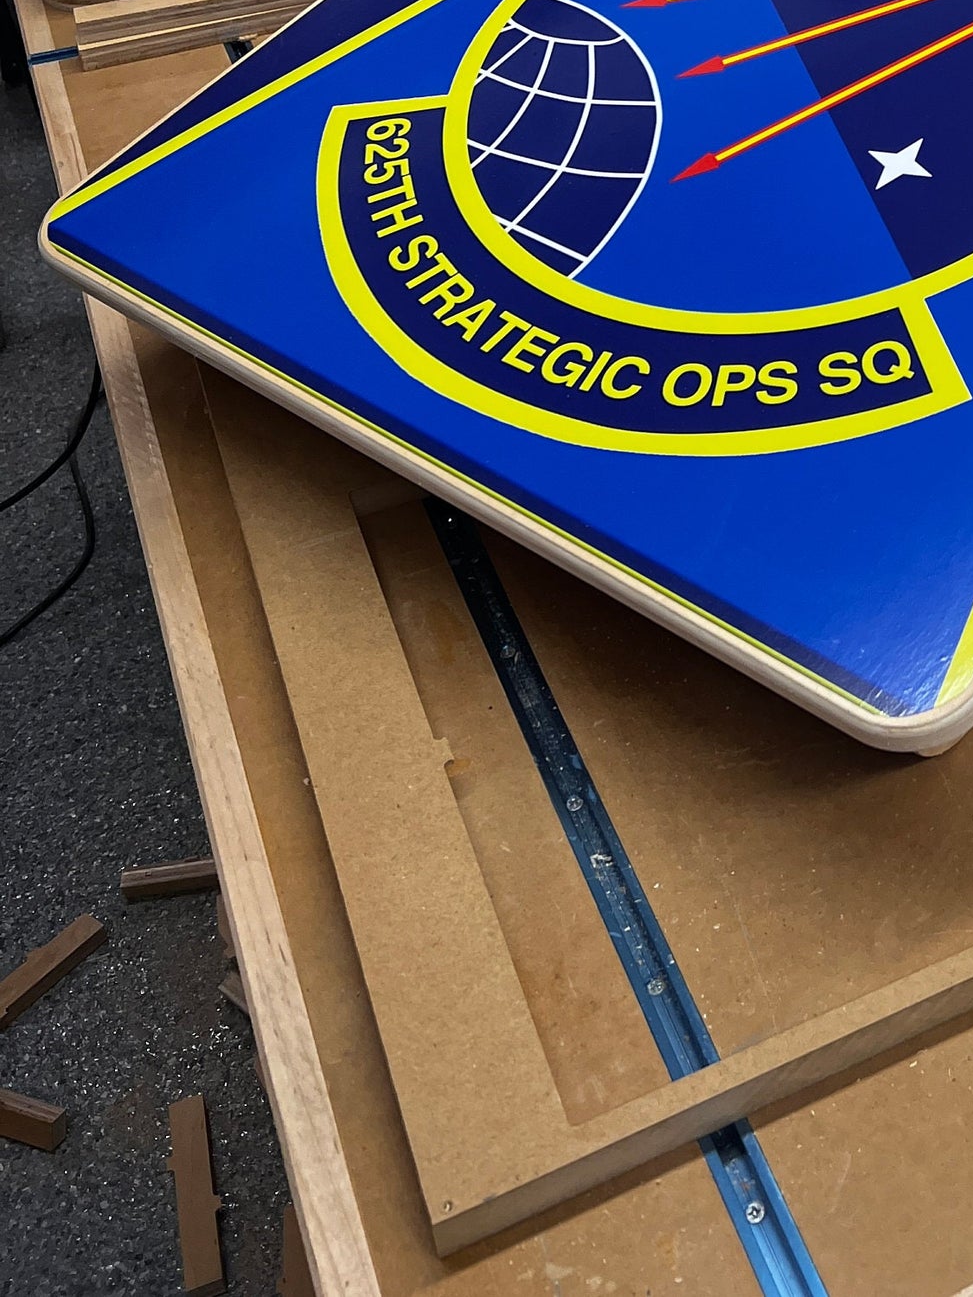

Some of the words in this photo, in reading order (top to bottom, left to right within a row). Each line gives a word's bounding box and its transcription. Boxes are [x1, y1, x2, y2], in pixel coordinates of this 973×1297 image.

[363, 117, 424, 239] 625TH
[387, 232, 651, 400] STRATEGIC
[662, 359, 800, 408] OPS
[818, 338, 917, 397] SQ
